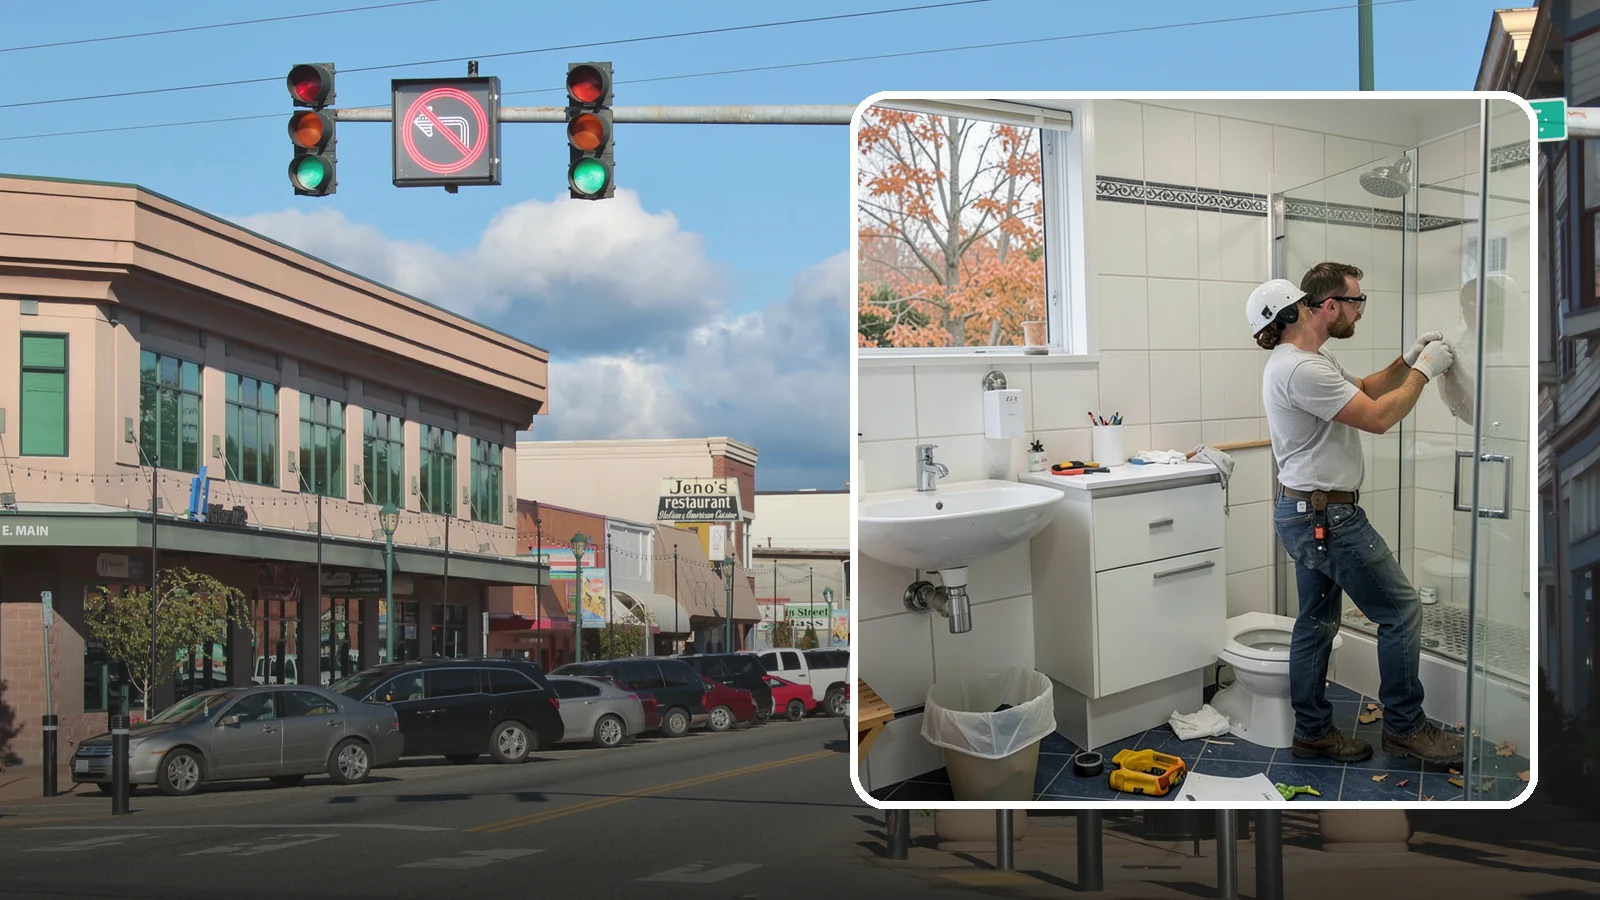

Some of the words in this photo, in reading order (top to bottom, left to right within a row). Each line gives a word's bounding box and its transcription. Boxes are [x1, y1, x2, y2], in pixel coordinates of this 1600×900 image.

[669, 480, 728, 494] Jeno's
[665, 497, 731, 509] restaurant
[658, 510, 682, 519] Italian
[686, 509, 715, 519] American
[716, 509, 738, 519] Cuisine
[2, 525, 13, 536] E.
[15, 525, 49, 536] MAIN
[797, 607, 828, 616] Street
